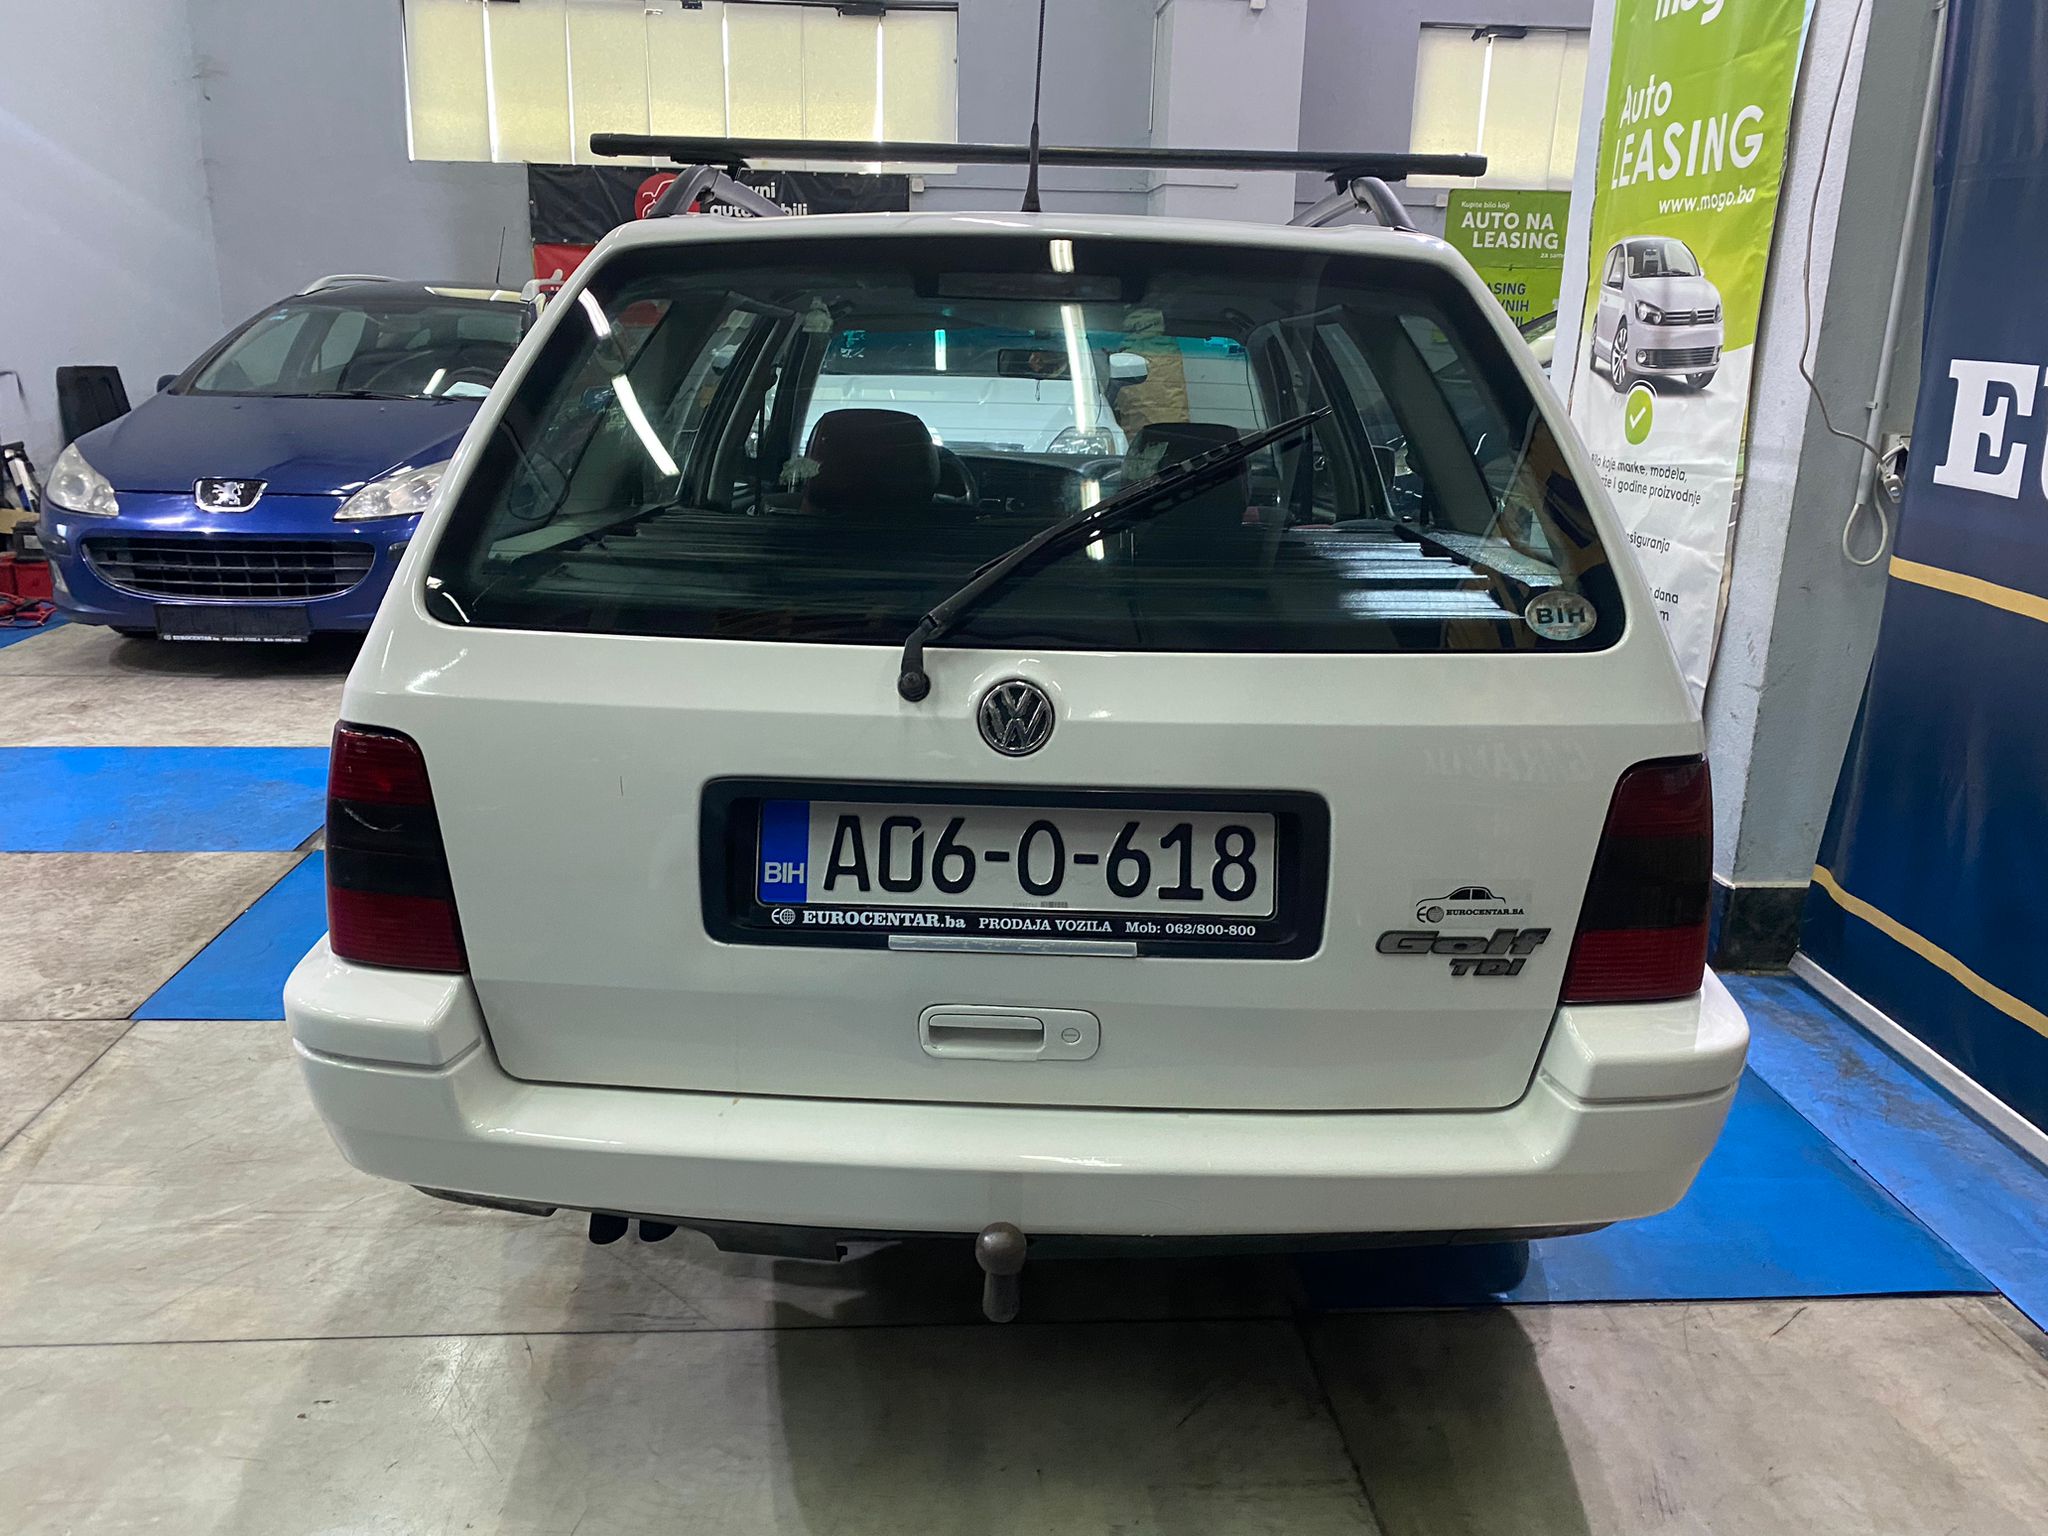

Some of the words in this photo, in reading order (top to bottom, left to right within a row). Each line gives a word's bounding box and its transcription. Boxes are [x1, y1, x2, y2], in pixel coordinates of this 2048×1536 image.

[1619, 74, 1673, 128] Auto
[1611, 105, 1765, 190] LEASING
[1658, 185, 1757, 214] www.mogo.ba
[1461, 211, 1520, 229] AUTO
[1526, 213, 1554, 230] NA
[1472, 231, 1560, 250] LEASING
[1933, 358, 2048, 502] E
[1617, 461, 1648, 476] marke,
[1650, 466, 1688, 484] modela,
[1617, 480, 1648, 495] godine
[1648, 484, 1702, 506] proizvodnje
[1627, 531, 1671, 554] siguranja
[1653, 587, 1679, 604] dana
[1535, 606, 1587, 625] BIH
[764, 861, 805, 884] BIH
[802, 910, 966, 929] EUROCENTAR.ba
[978, 917, 1052, 931] PRODAJA
[1055, 919, 1113, 933] VOZILA
[1125, 921, 1161, 934] Mob:
[1165, 923, 1256, 937] 062/800-800
[1446, 908, 1525, 917] EUROCENTAR.BA
[1375, 927, 1552, 955] Golf
[1449, 958, 1527, 976] TDI
